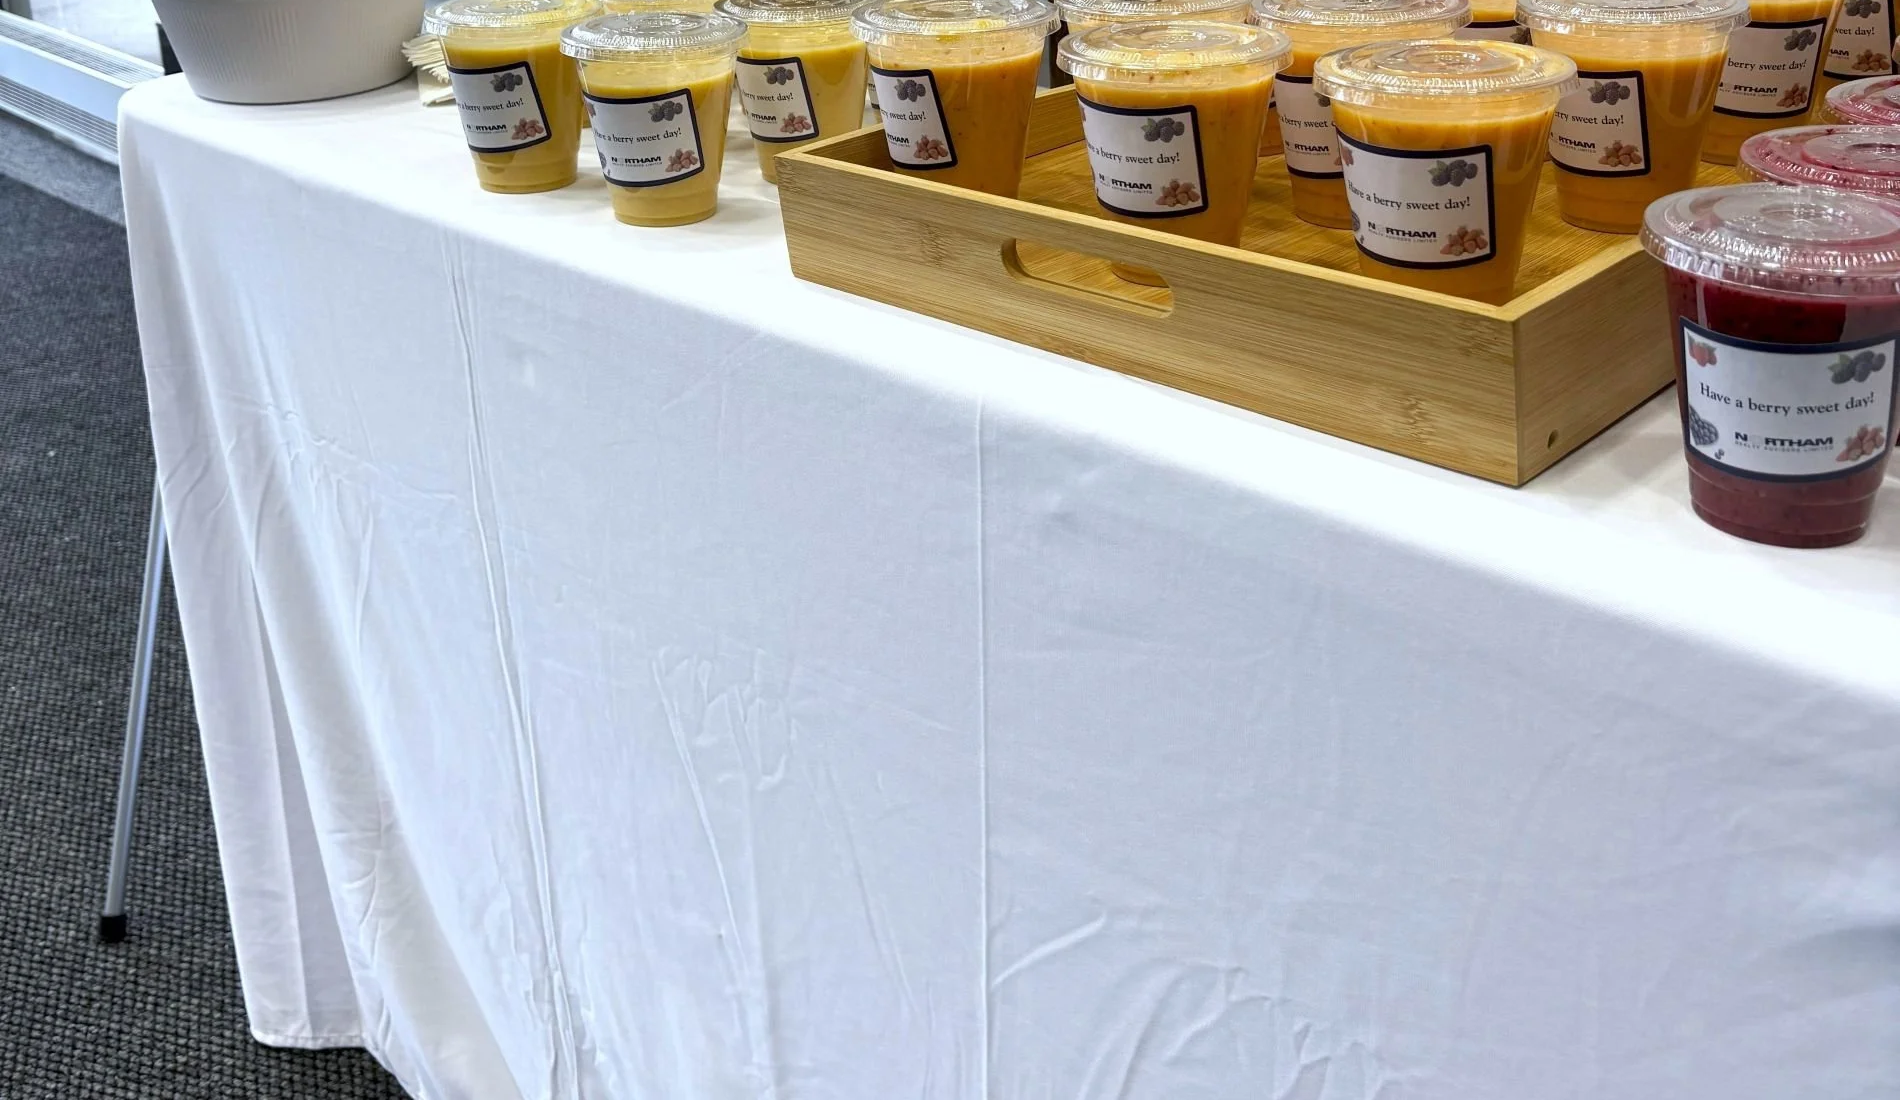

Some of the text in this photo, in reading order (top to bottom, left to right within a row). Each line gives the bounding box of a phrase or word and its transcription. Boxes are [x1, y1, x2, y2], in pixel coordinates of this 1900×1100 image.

[1854, 26, 1876, 37] day!
[1727, 57, 1808, 72] berry sweet day!
[1719, 82, 1778, 94] RTHAM
[776, 92, 794, 102] day!
[482, 103, 505, 112] sweet
[506, 97, 525, 109] day!
[908, 110, 927, 122] day!
[1571, 114, 1598, 125] sweet
[1601, 114, 1625, 127] day!
[466, 124, 507, 132] NRTHAM
[1303, 120, 1329, 128] sweet
[612, 129, 635, 145] berry
[636, 133, 661, 143] sweet
[663, 126, 682, 140] day!
[1551, 132, 1597, 149] RTHAM
[1285, 140, 1330, 152] NRTHAM
[1100, 146, 1123, 164] berry
[1125, 154, 1154, 165] sweet
[1157, 151, 1180, 165] day!
[1366, 193, 1372, 202] a
[1373, 192, 1402, 211] berry
[1406, 200, 1441, 211] sweet
[1444, 195, 1471, 211] day!
[1700, 381, 1875, 416] Have a berry sweet day!
